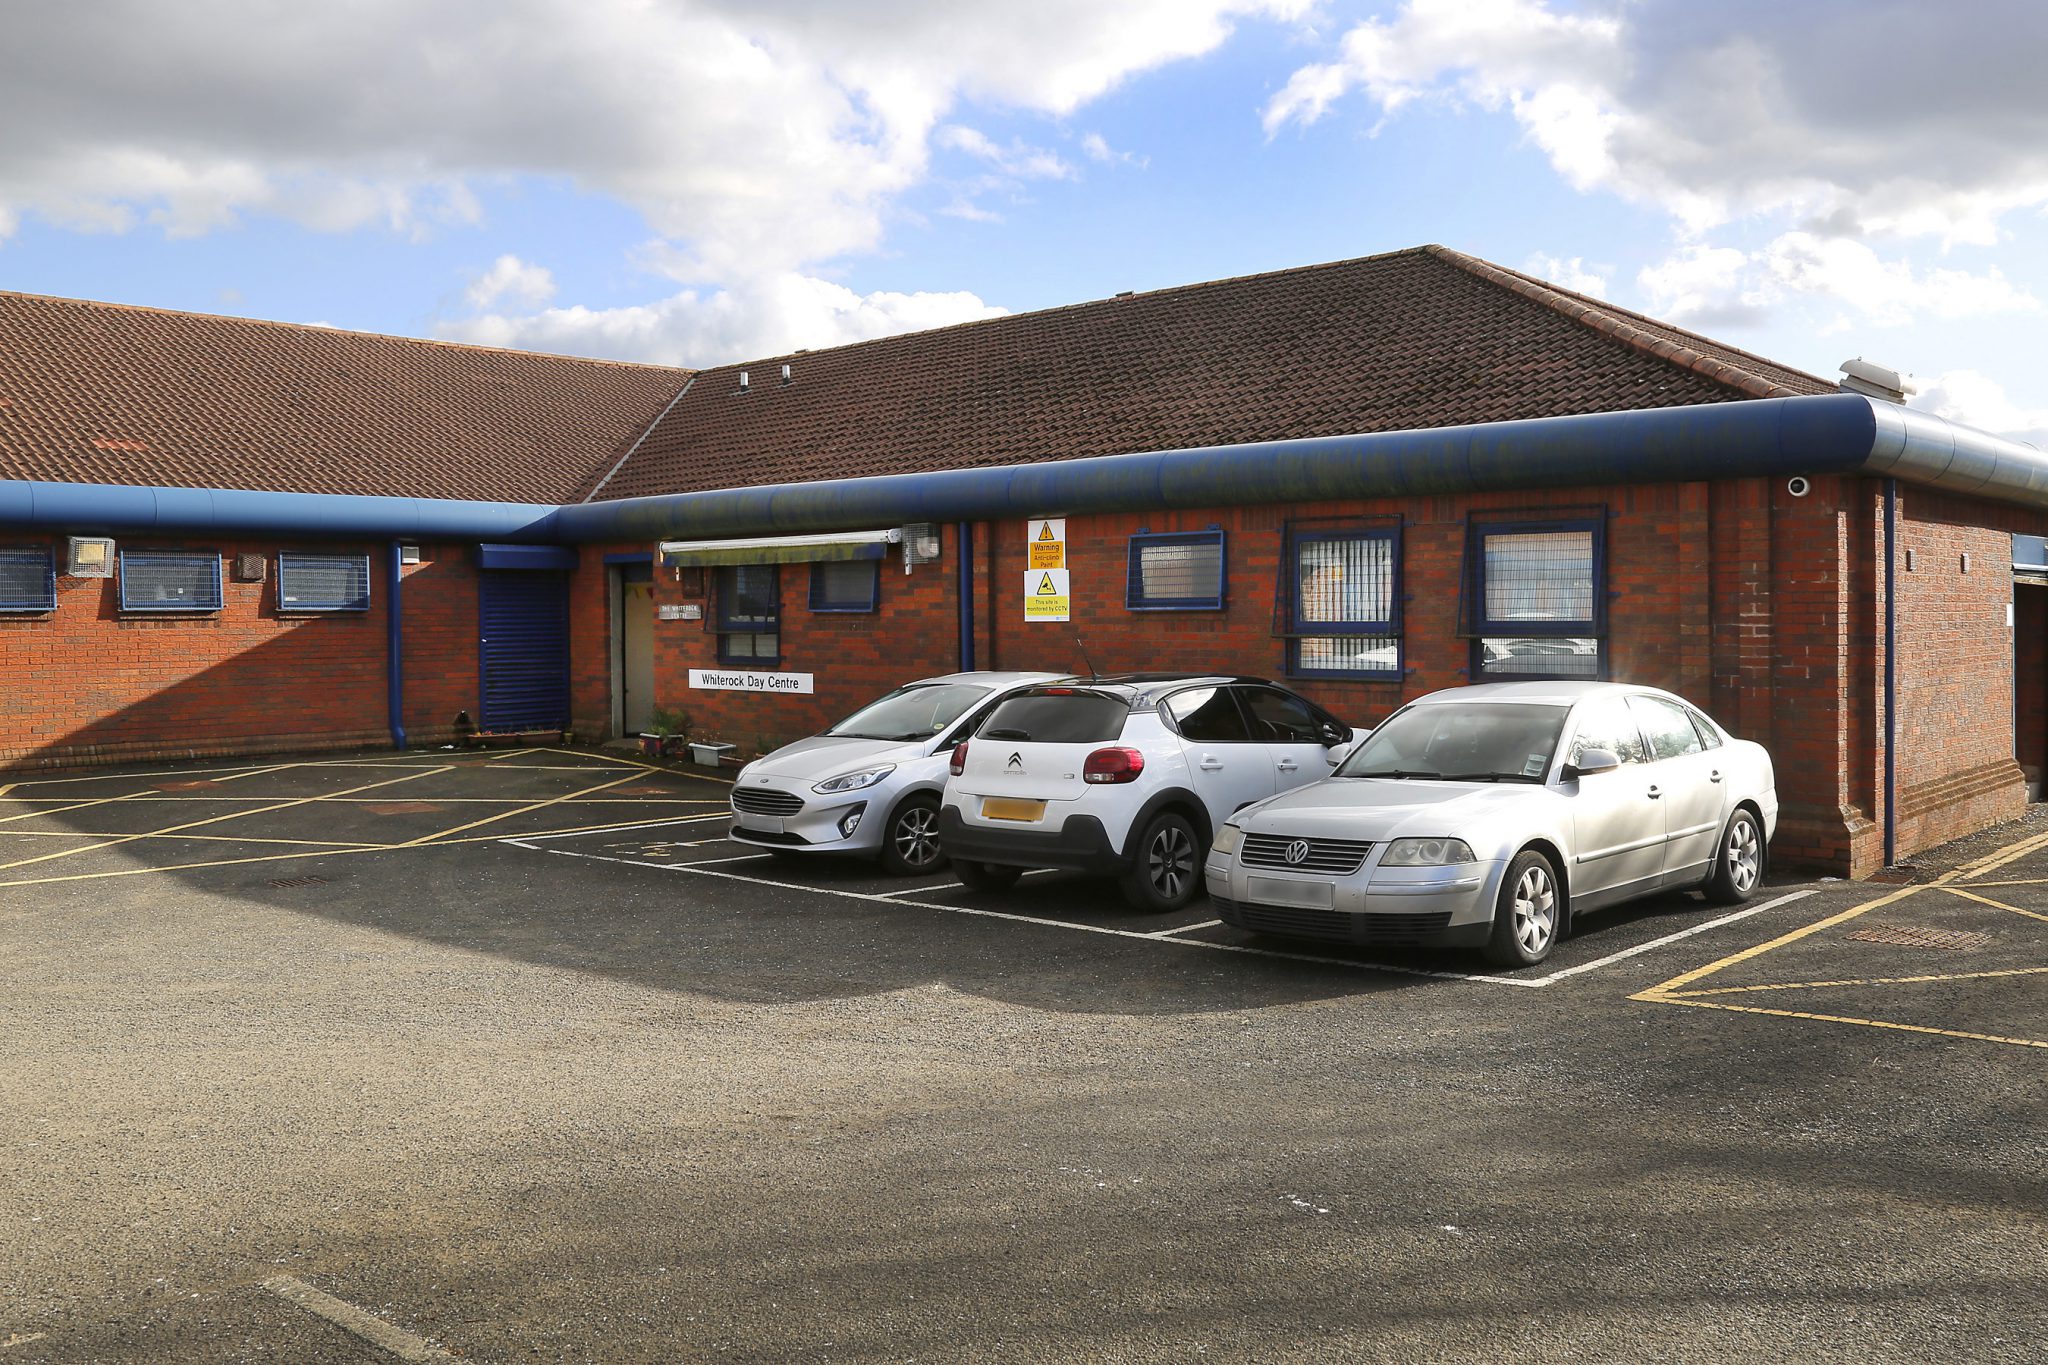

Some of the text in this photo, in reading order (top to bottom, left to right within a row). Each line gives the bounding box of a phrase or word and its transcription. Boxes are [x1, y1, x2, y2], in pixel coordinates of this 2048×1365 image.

[1034, 544, 1060, 552] Warning
[702, 673, 799, 690] Whiterock Day Centre
